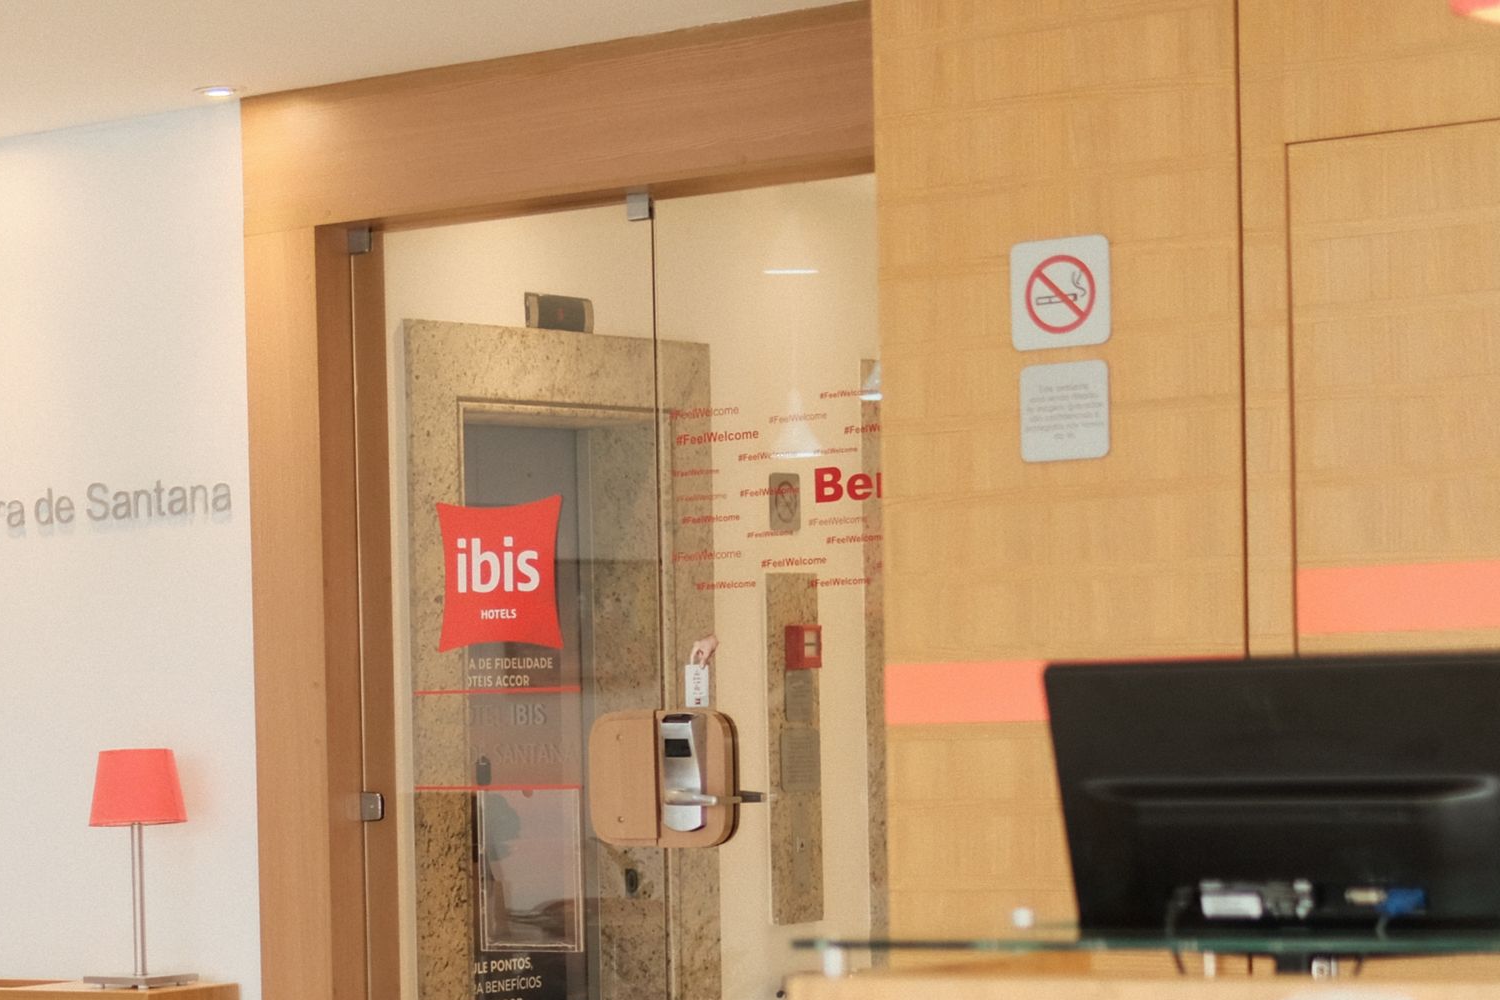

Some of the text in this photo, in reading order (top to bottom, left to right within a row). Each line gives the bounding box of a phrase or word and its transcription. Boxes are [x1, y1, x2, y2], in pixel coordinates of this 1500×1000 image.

[669, 406, 740, 420] #FeelWelcome
[676, 430, 759, 446] #FeelWelcome
[34, 487, 76, 529] de
[86, 478, 232, 524] Santana
[682, 514, 740, 525] #FeelWelcome
[826, 534, 883, 545] #FeelWelcom
[672, 549, 741, 563] #FeelWelcome
[761, 557, 827, 568] #FeelWelcome
[457, 536, 540, 593] ibis
[696, 581, 756, 591] #FeelWelcome
[810, 577, 872, 588] #FeelWelcome
[481, 608, 517, 620] HOTELS
[478, 658, 492, 670] DE
[495, 657, 553, 670] FIDELIDADE
[495, 675, 530, 687] ACCOR
[509, 703, 546, 726] IBIS
[490, 957, 534, 973] PONTOS,
[485, 975, 542, 994] BENEFÍCIOS
